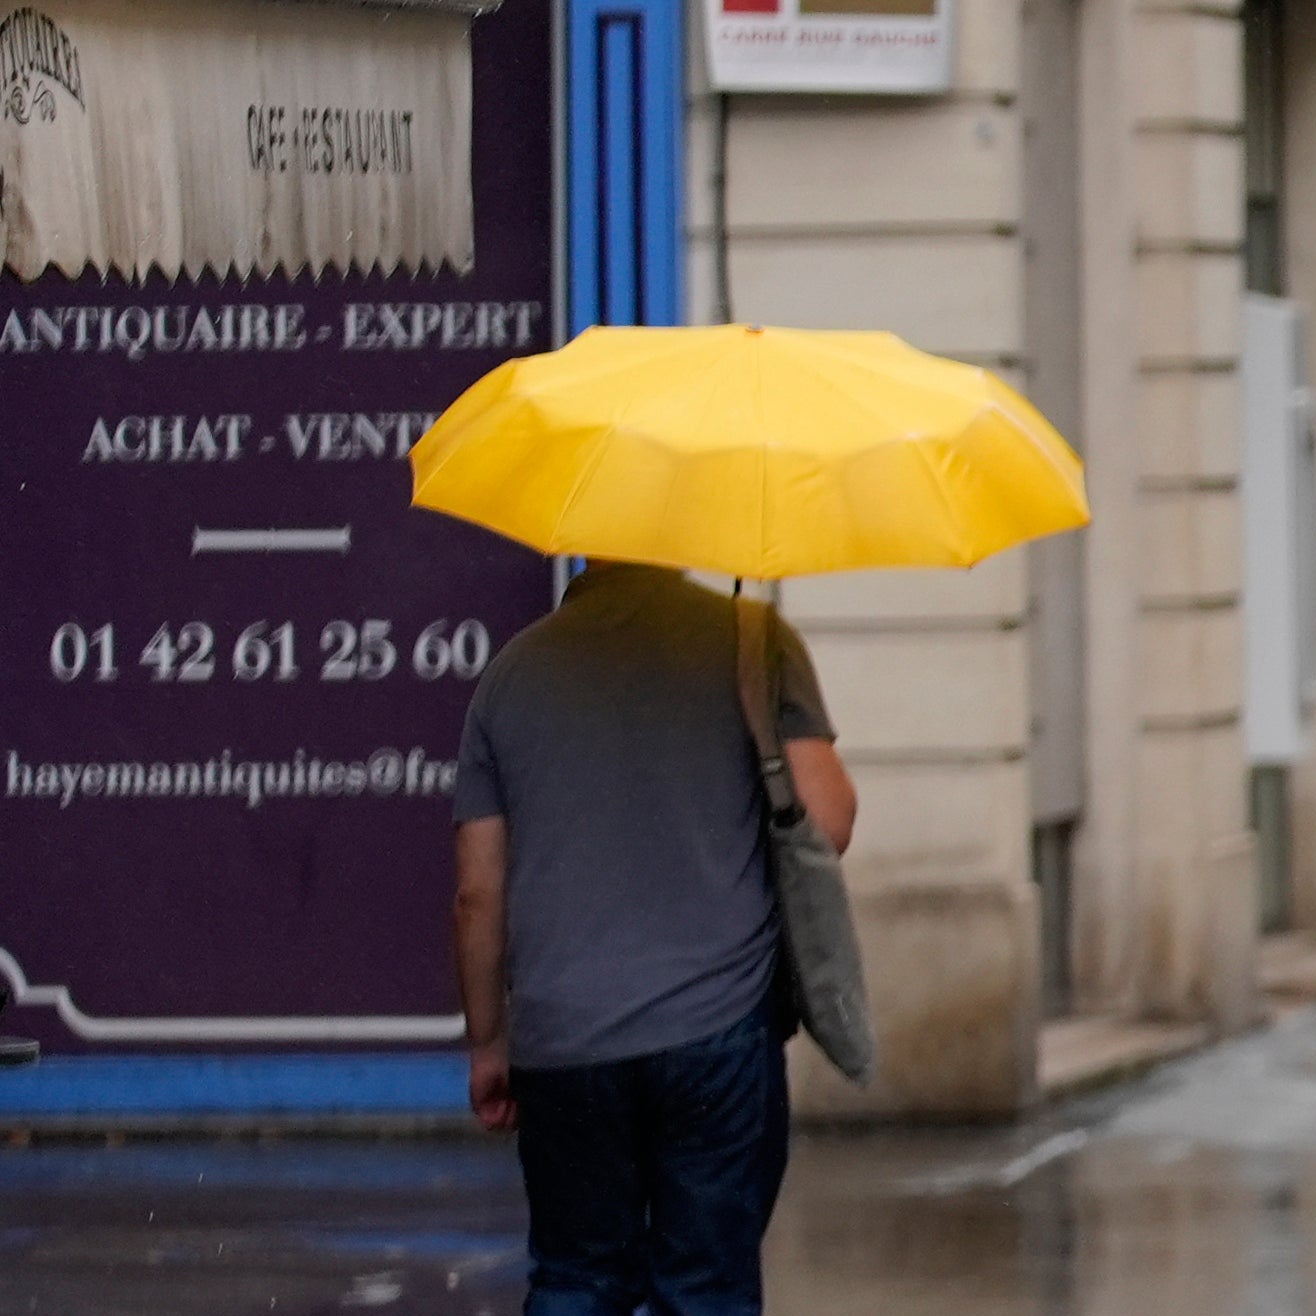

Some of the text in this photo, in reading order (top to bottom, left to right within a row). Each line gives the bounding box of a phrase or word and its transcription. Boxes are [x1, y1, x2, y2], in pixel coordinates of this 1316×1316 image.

[0, 305, 305, 361] ANTIQUAIRE
[342, 303, 541, 350] EXPERT
[82, 414, 252, 462] ACHAT
[50, 618, 491, 683] 01 42 61 25 60
